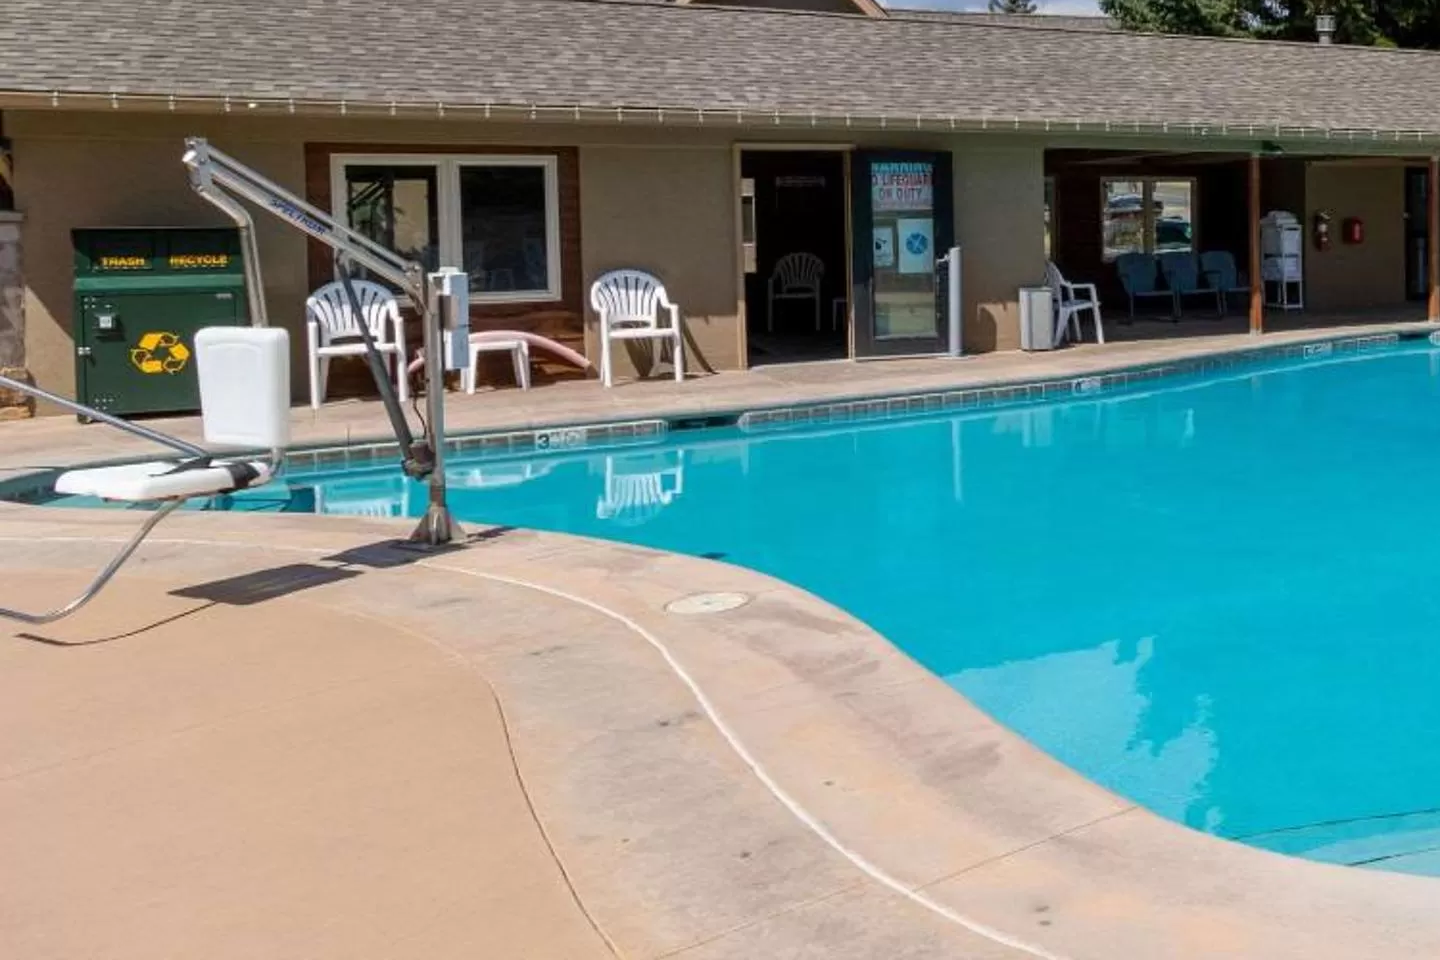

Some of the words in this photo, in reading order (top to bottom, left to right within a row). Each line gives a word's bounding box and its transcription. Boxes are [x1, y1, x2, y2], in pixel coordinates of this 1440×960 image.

[102, 256, 145, 267] TRASH
[170, 254, 228, 266] RECYCLE
[538, 433, 550, 450] 3
